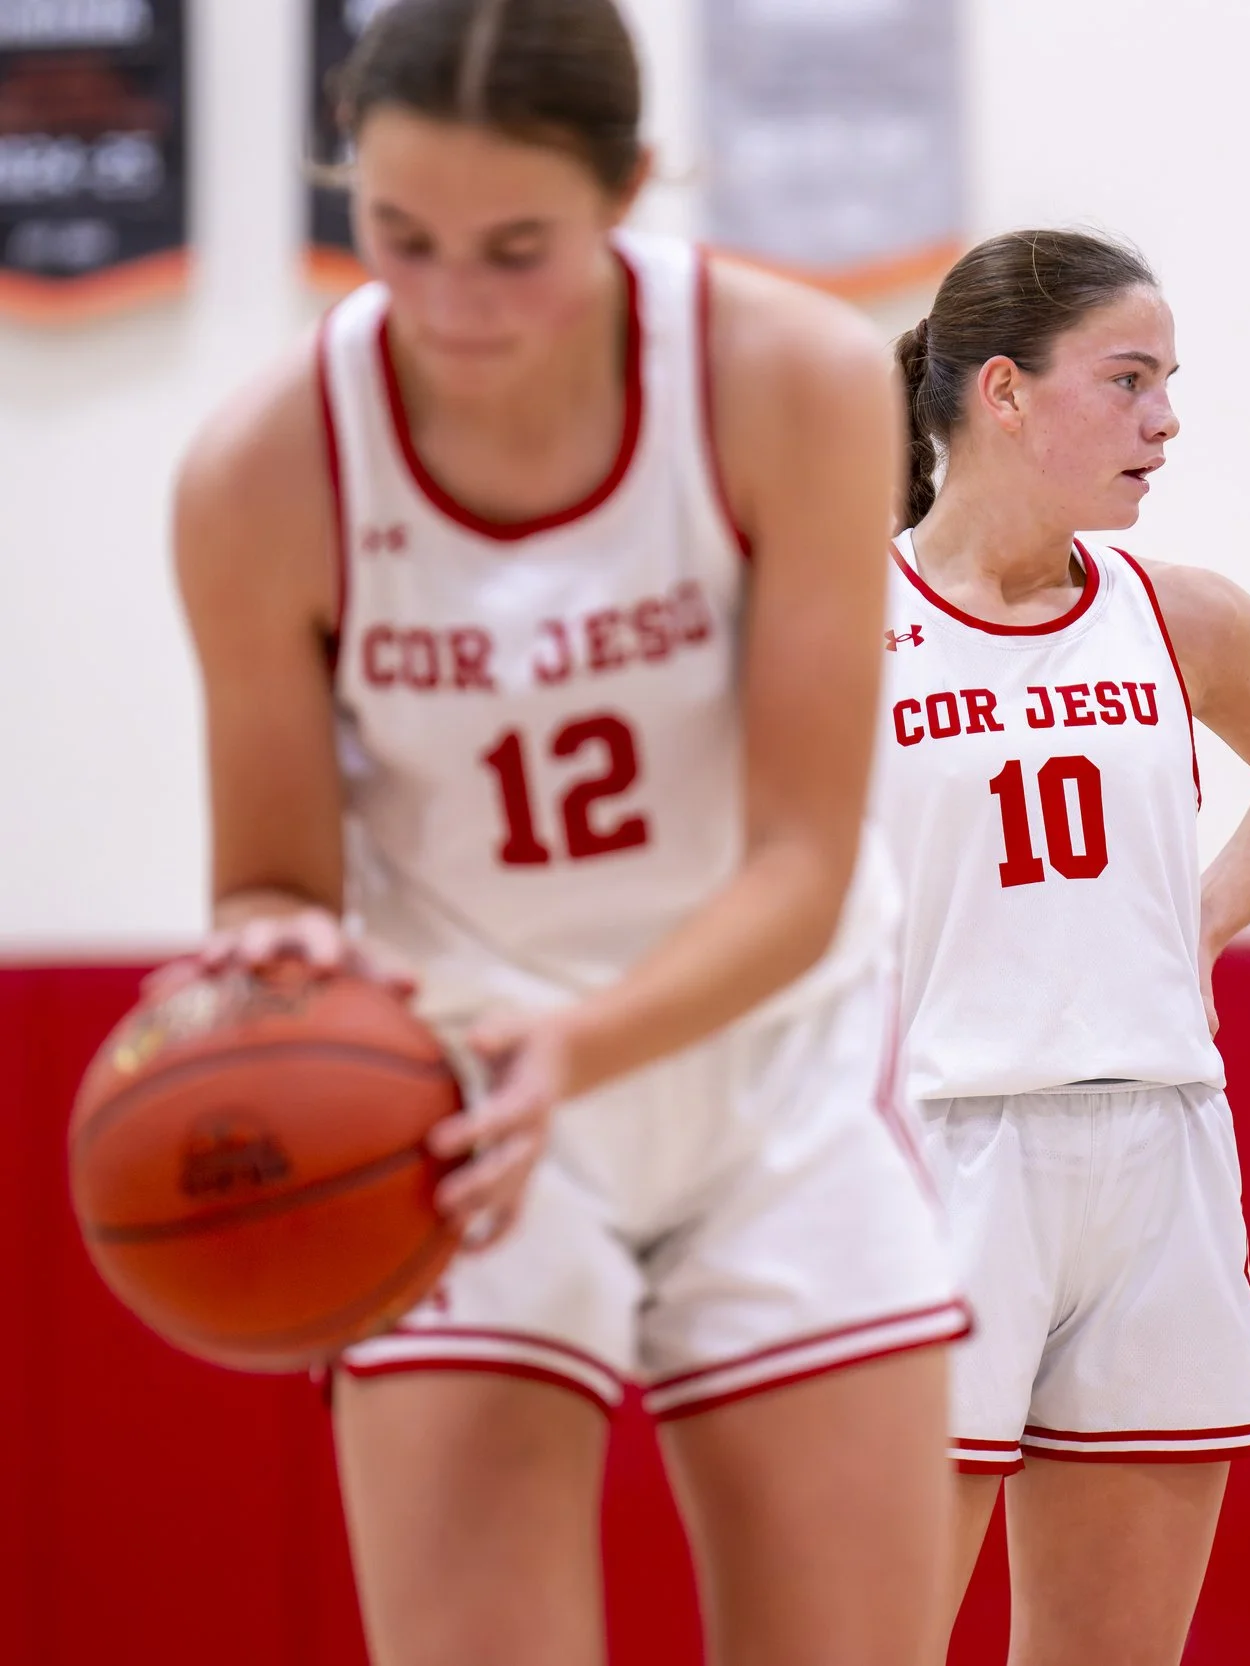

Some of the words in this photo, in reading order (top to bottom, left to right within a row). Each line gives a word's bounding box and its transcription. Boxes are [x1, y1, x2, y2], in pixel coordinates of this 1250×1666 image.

[361, 622, 496, 693] COR
[893, 688, 1005, 747] COR
[1025, 681, 1159, 729] JESU
[483, 714, 649, 868] 12
[989, 755, 1109, 888] 10
